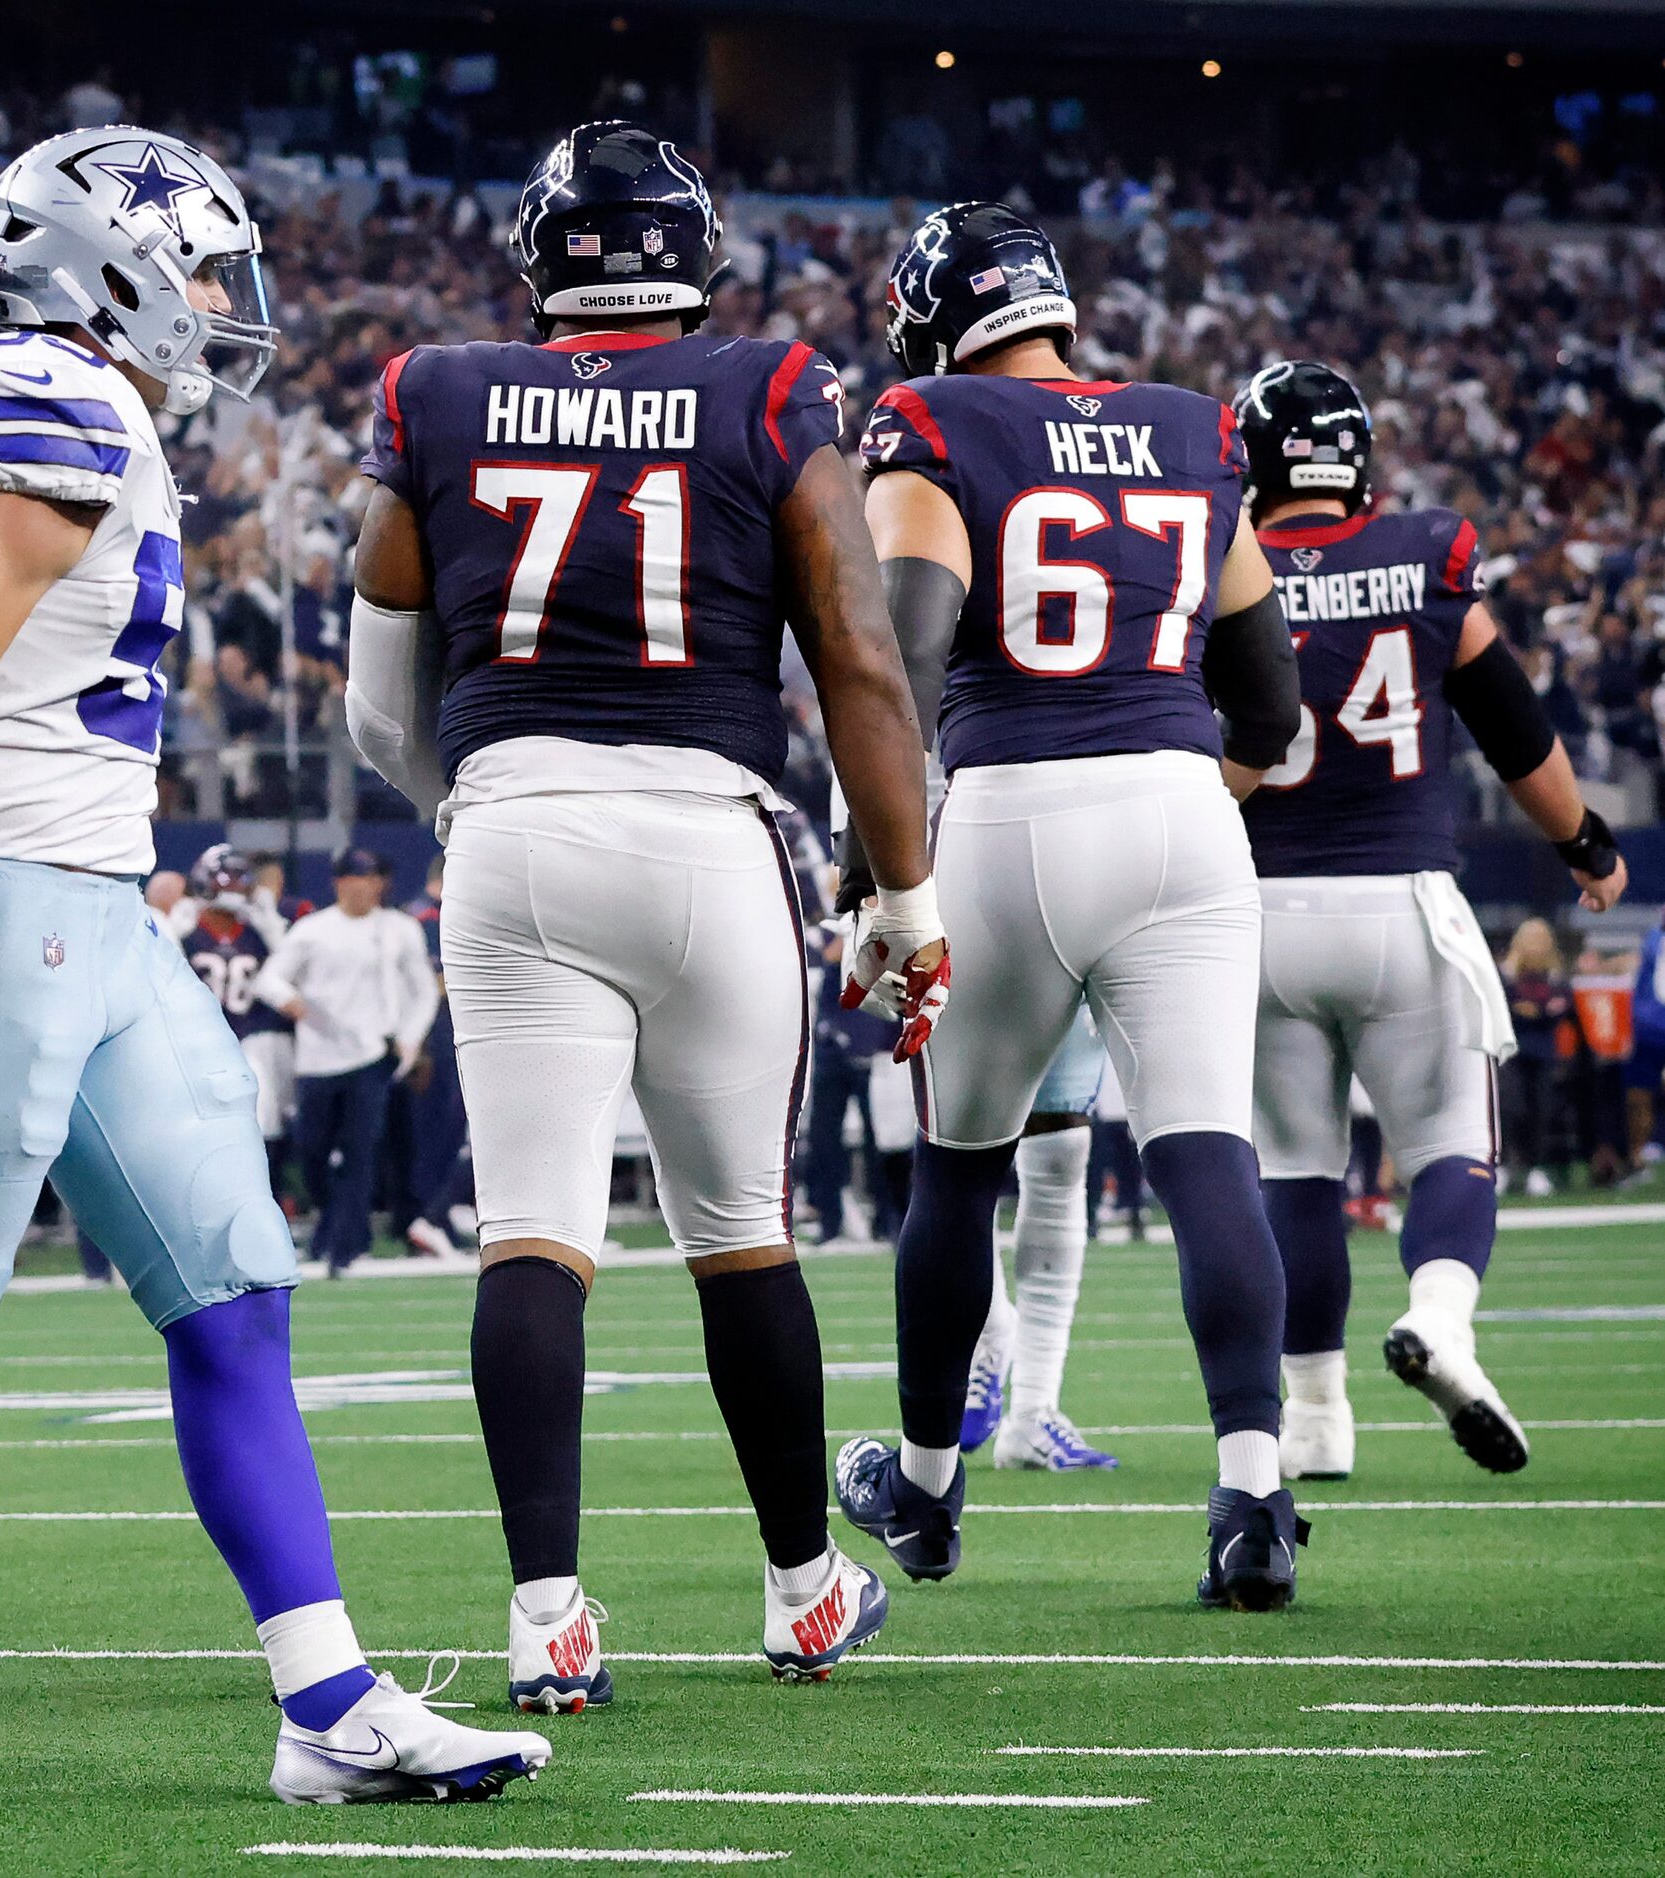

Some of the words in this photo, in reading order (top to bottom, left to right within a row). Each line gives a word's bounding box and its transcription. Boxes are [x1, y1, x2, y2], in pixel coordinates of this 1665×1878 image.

[579, 295, 635, 307] CHOOSE
[639, 294, 672, 305] LOVE
[984, 308, 1028, 333] INSPIRE
[1030, 302, 1064, 316] CHANGE
[486, 385, 697, 449] HOWARD
[1045, 420, 1163, 478] HECK
[469, 458, 695, 668] 71
[997, 485, 1213, 677] 67
